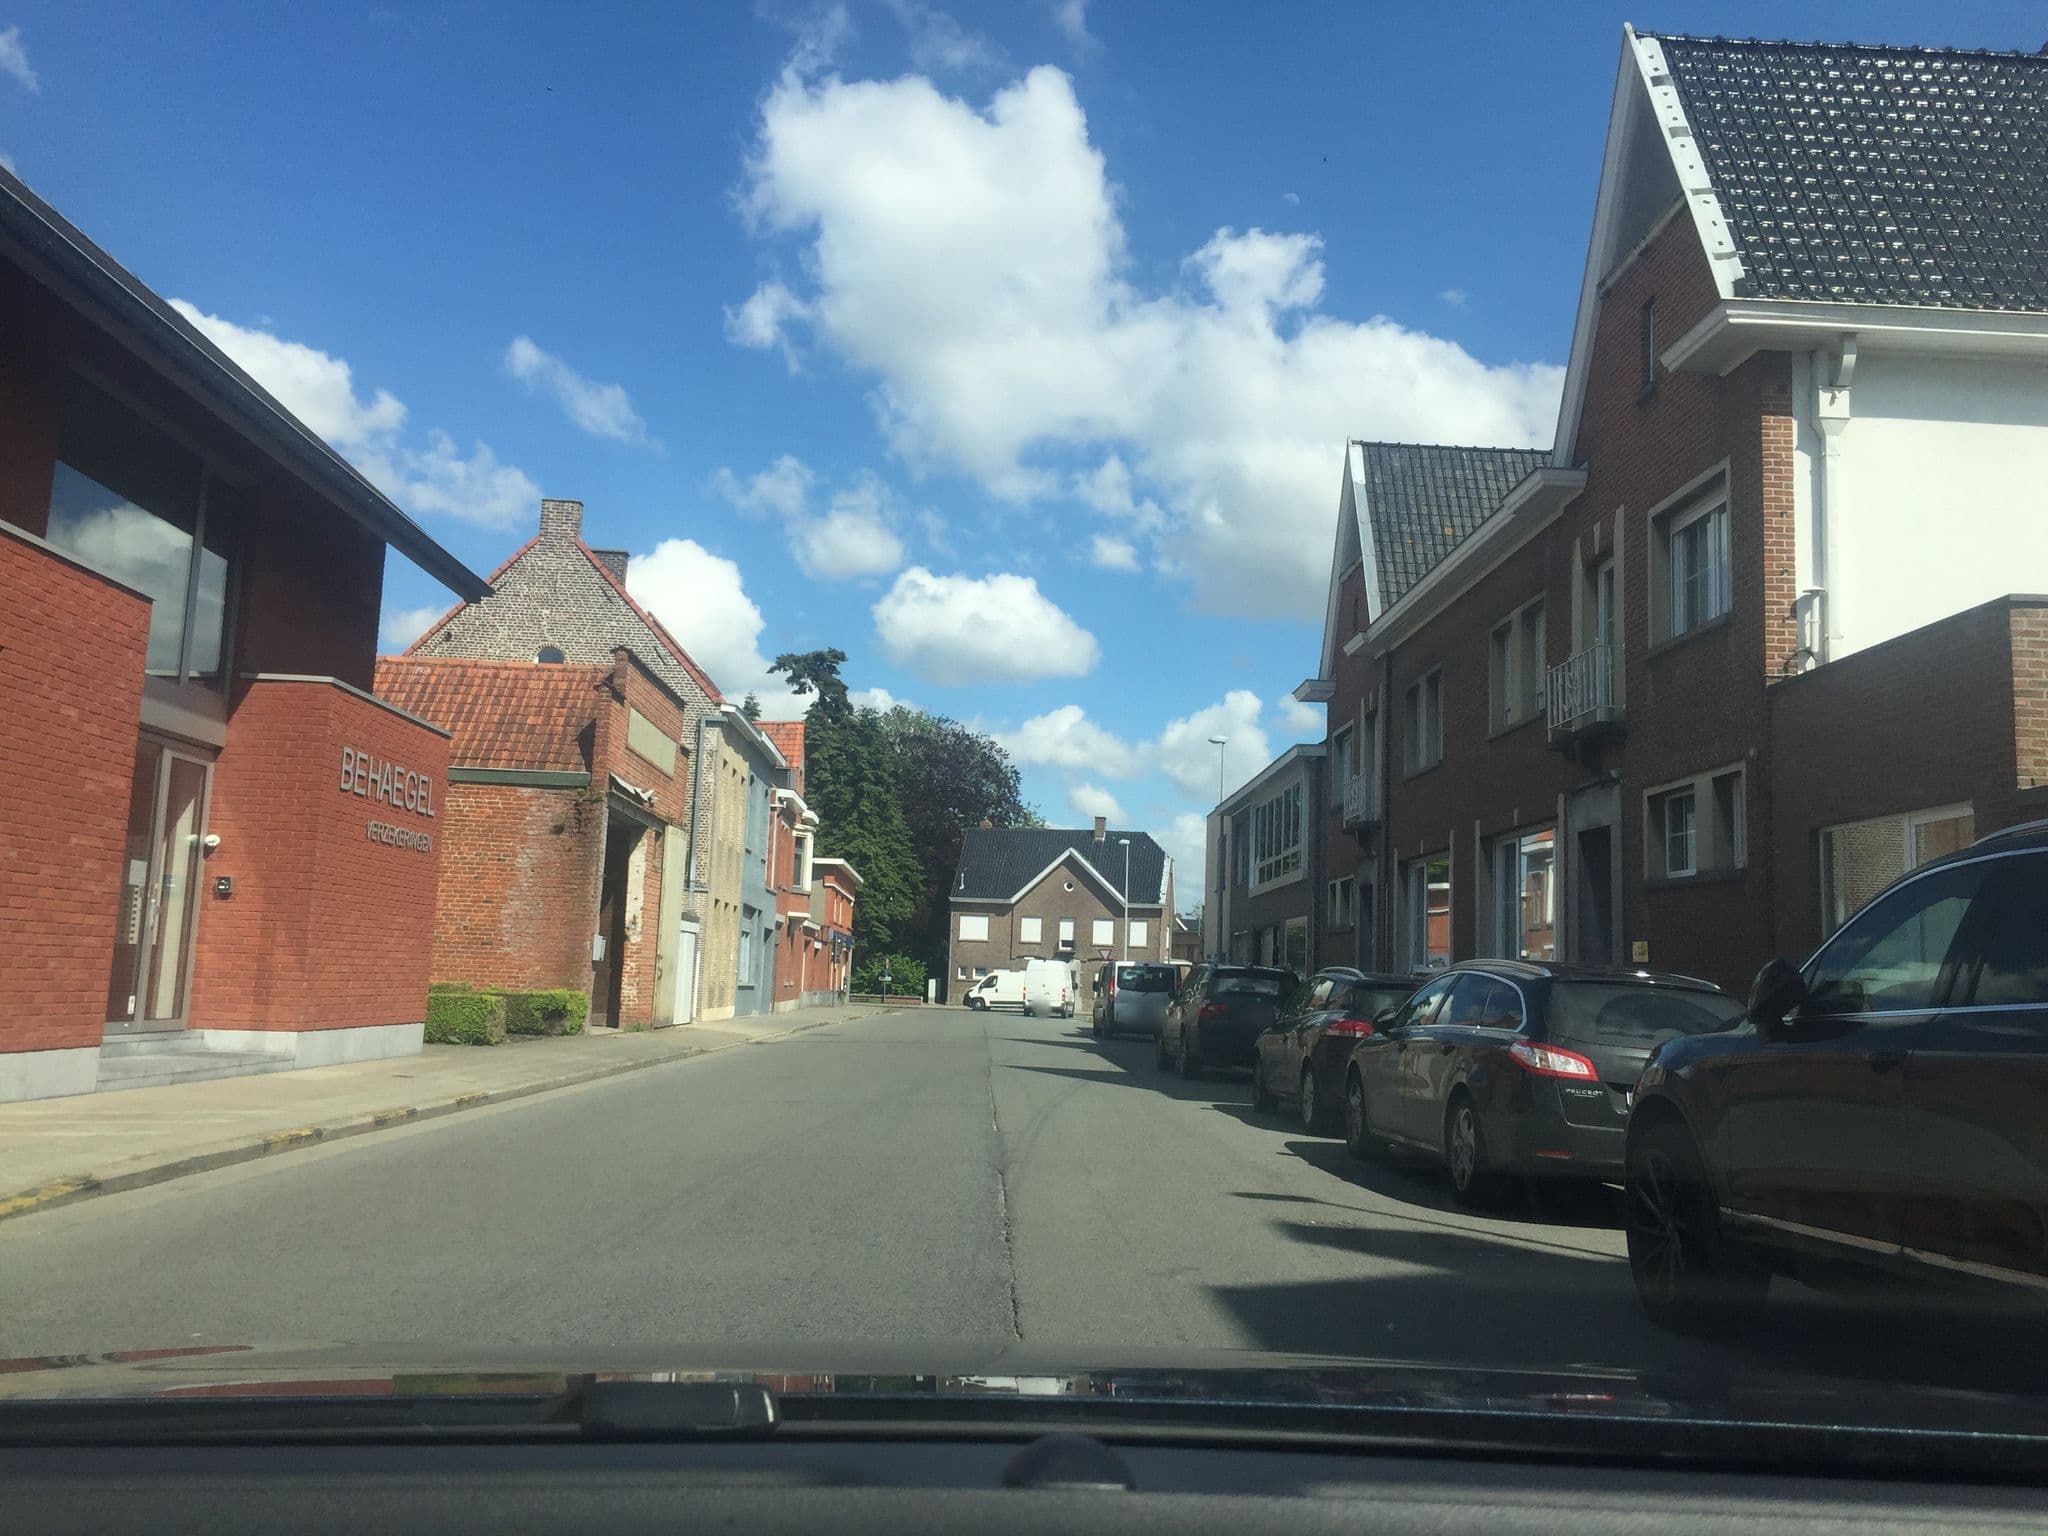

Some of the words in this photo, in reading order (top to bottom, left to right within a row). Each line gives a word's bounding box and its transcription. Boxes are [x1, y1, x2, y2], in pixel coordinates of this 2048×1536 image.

[340, 746, 436, 817] BEHAEGEL
[367, 819, 433, 853] VERZEKERINGEN
[1565, 1088, 1604, 1096] PEUGEOT
